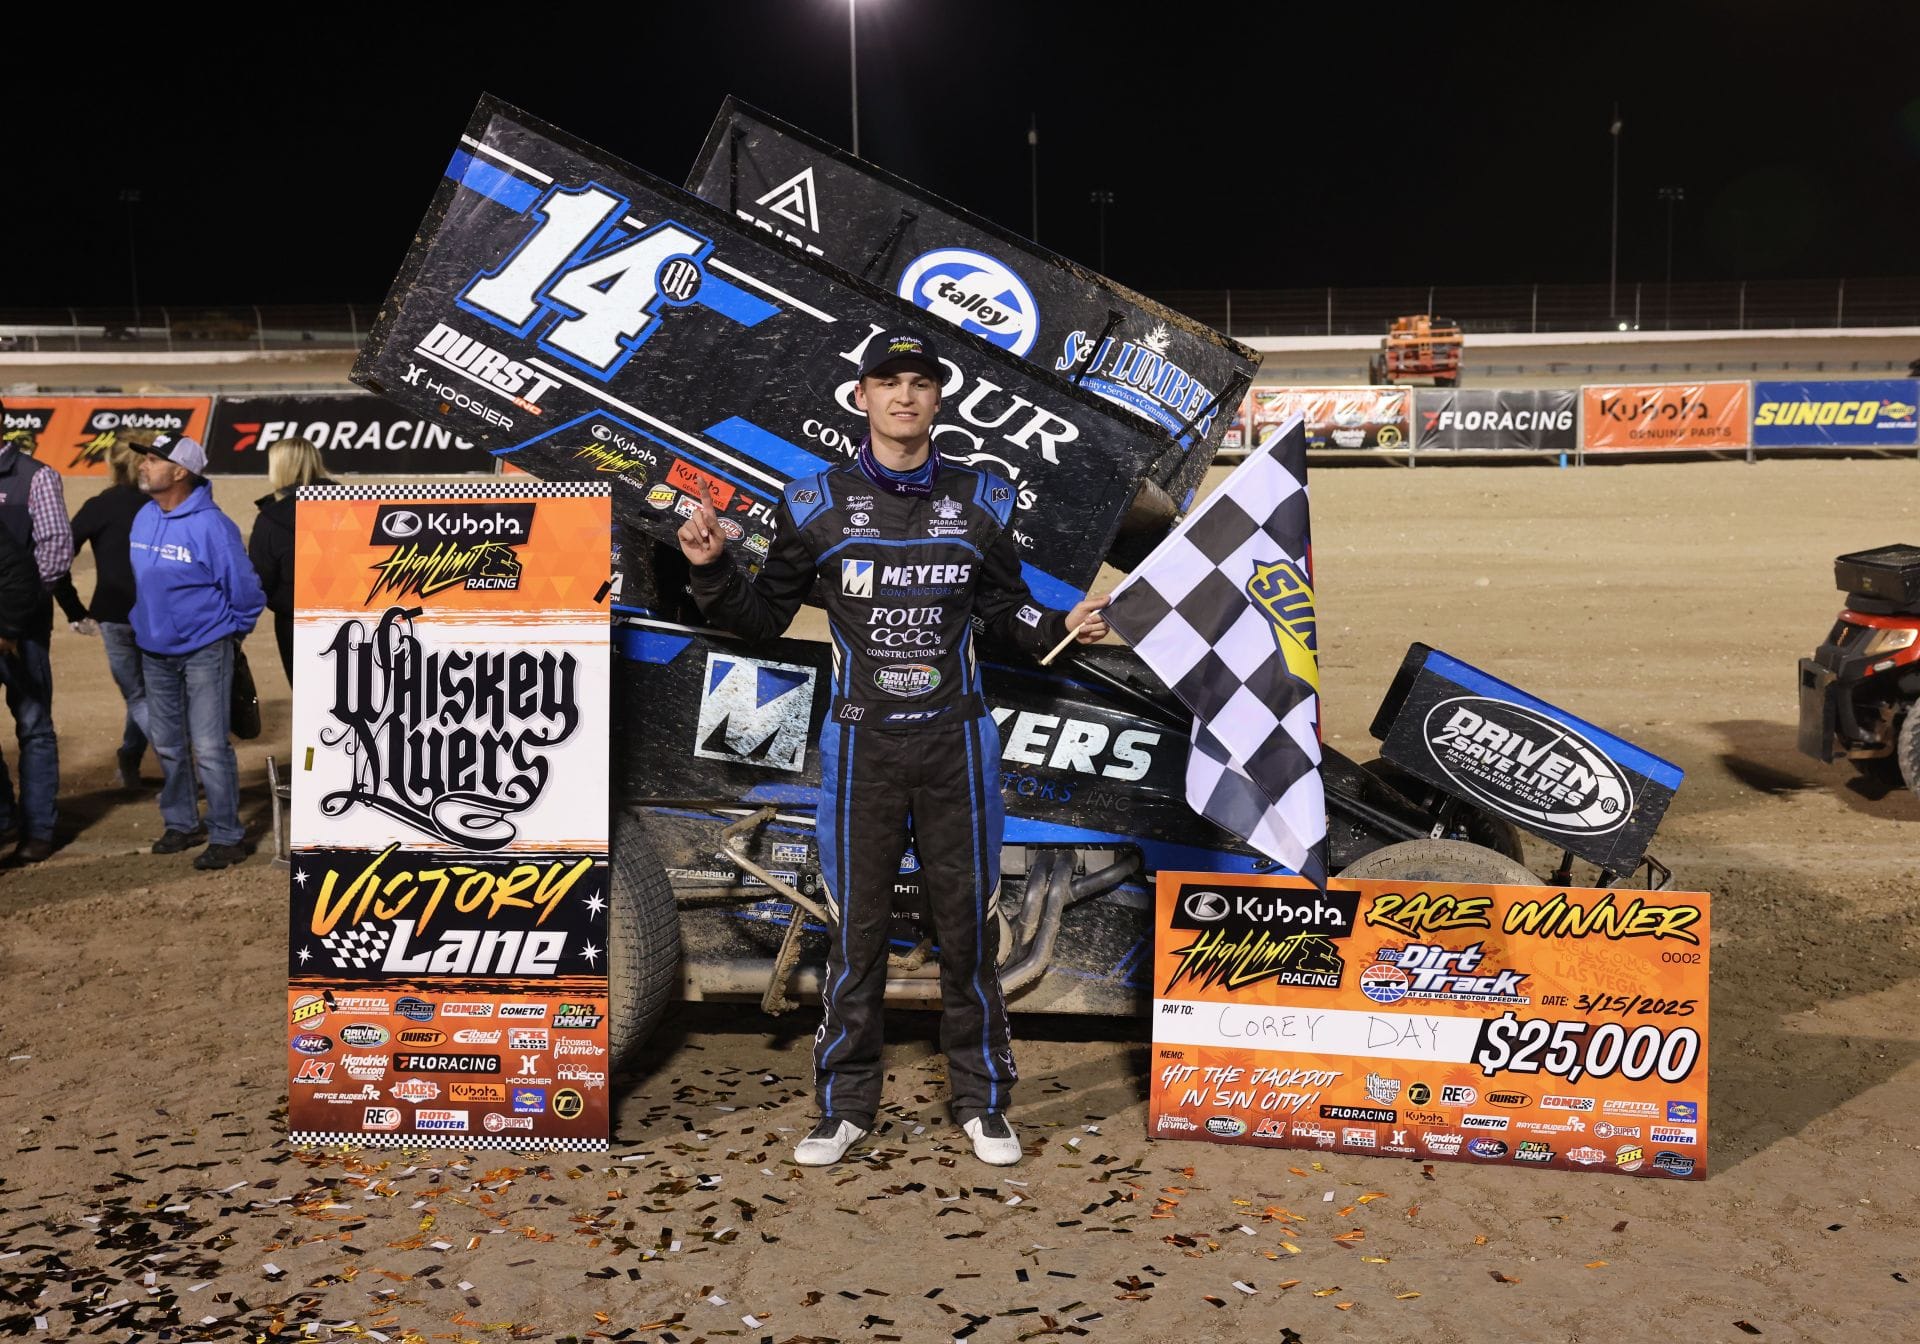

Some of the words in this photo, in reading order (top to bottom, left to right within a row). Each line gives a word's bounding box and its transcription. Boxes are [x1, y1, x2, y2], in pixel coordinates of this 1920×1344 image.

[457, 182, 713, 379] 14
[938, 280, 1009, 326] talley
[419, 322, 562, 404] DURST
[1109, 341, 1220, 440] LUMBER
[426, 378, 514, 431] HOOSIER
[1072, 375, 1102, 391] uality
[1107, 385, 1136, 402] Service
[1139, 399, 1182, 434] Commitmen
[1599, 397, 1708, 422] Kubota
[4, 413, 42, 429] bota
[121, 409, 182, 429] Kubota
[1438, 410, 1574, 431] FLORACING
[1754, 401, 1881, 426] SUNOCO
[1629, 427, 1684, 440] GENUINE
[1690, 426, 1732, 438] PARTS
[613, 434, 658, 467] Kubota
[617, 473, 643, 489] RACING
[428, 512, 523, 536] Kubota
[1012, 528, 1035, 550] NC.
[881, 564, 971, 586] MEYERS
[466, 578, 517, 590] RACING
[867, 607, 943, 626] FOUR
[840, 703, 864, 720] K1
[991, 707, 1162, 782] ERS
[1446, 706, 1598, 797] DRIVEN
[1445, 754, 1458, 765] FOR
[1461, 763, 1513, 790] LIFESAVING
[1514, 788, 1552, 810] ORGANS
[1447, 748, 1479, 766] RACING
[1481, 764, 1490, 772] TO
[1492, 769, 1512, 783] END
[1514, 780, 1532, 792] THE
[1534, 789, 1557, 804] WAIT
[1513, 768, 1585, 807] LIVES
[688, 869, 735, 879] CARRILLO
[311, 842, 593, 936] VICTORY
[1237, 896, 1346, 926] Kubota
[1366, 893, 1492, 937] RACE
[1503, 894, 1700, 945] WINNER
[382, 919, 568, 974] Lane
[1378, 948, 1404, 961] The
[1402, 941, 1485, 971] Dirt
[1661, 951, 1701, 964] 0002
[1280, 972, 1338, 987] RACING
[1411, 966, 1530, 995] Track
[336, 997, 389, 1007] CAPITOL
[1488, 996, 1528, 1004] SPEEDWAY
[1541, 994, 1568, 1007] DATE:
[1573, 992, 1698, 1017] 3/15/2025
[443, 1004, 481, 1013] COMP
[500, 1006, 545, 1016] COMETIC
[566, 1003, 593, 1015] Dirt
[1161, 1004, 1179, 1014] PAY
[1180, 1005, 1194, 1015] TO:
[553, 1015, 602, 1027] DRAFT
[1218, 1006, 1327, 1042] COREY
[1367, 1014, 1439, 1051] DAY
[400, 1032, 441, 1042] DURST
[453, 1029, 501, 1043] Eibach
[1159, 1050, 1185, 1060] MEMO:
[1478, 1012, 1702, 1084] $25,000
[340, 1054, 389, 1067] Hendrick
[409, 1056, 497, 1071] FLORACING
[298, 1059, 335, 1079] K1
[347, 1065, 386, 1075] Cars.com
[506, 1077, 552, 1085] HOOSIER
[1161, 1063, 1200, 1089] HIT
[1203, 1065, 1246, 1092] THE
[1250, 1067, 1345, 1088] JACKPOT
[451, 1084, 498, 1097] Kubota
[1180, 1088, 1210, 1107] IN
[1212, 1089, 1256, 1109] SIN
[1260, 1091, 1320, 1114] CITY!
[1489, 1094, 1528, 1105] DURST
[1543, 1097, 1582, 1107] COMP
[1602, 1100, 1660, 1111] CAPITOL
[419, 1111, 455, 1119] ROTO-
[1331, 1106, 1395, 1122] FLORACING
[1405, 1111, 1443, 1123] Kubota
[417, 1120, 464, 1129] ROOTER
[504, 1118, 531, 1128] SUPPLY
[1256, 1117, 1286, 1133] K1
[1463, 1117, 1507, 1128] COMETIC
[1422, 1131, 1464, 1144] Hendrick
[1613, 1127, 1639, 1137] SUPPLY
[1651, 1134, 1694, 1143] ROOTER
[1653, 1127, 1686, 1135] ROTO-
[1514, 1150, 1554, 1161] DRAFT
